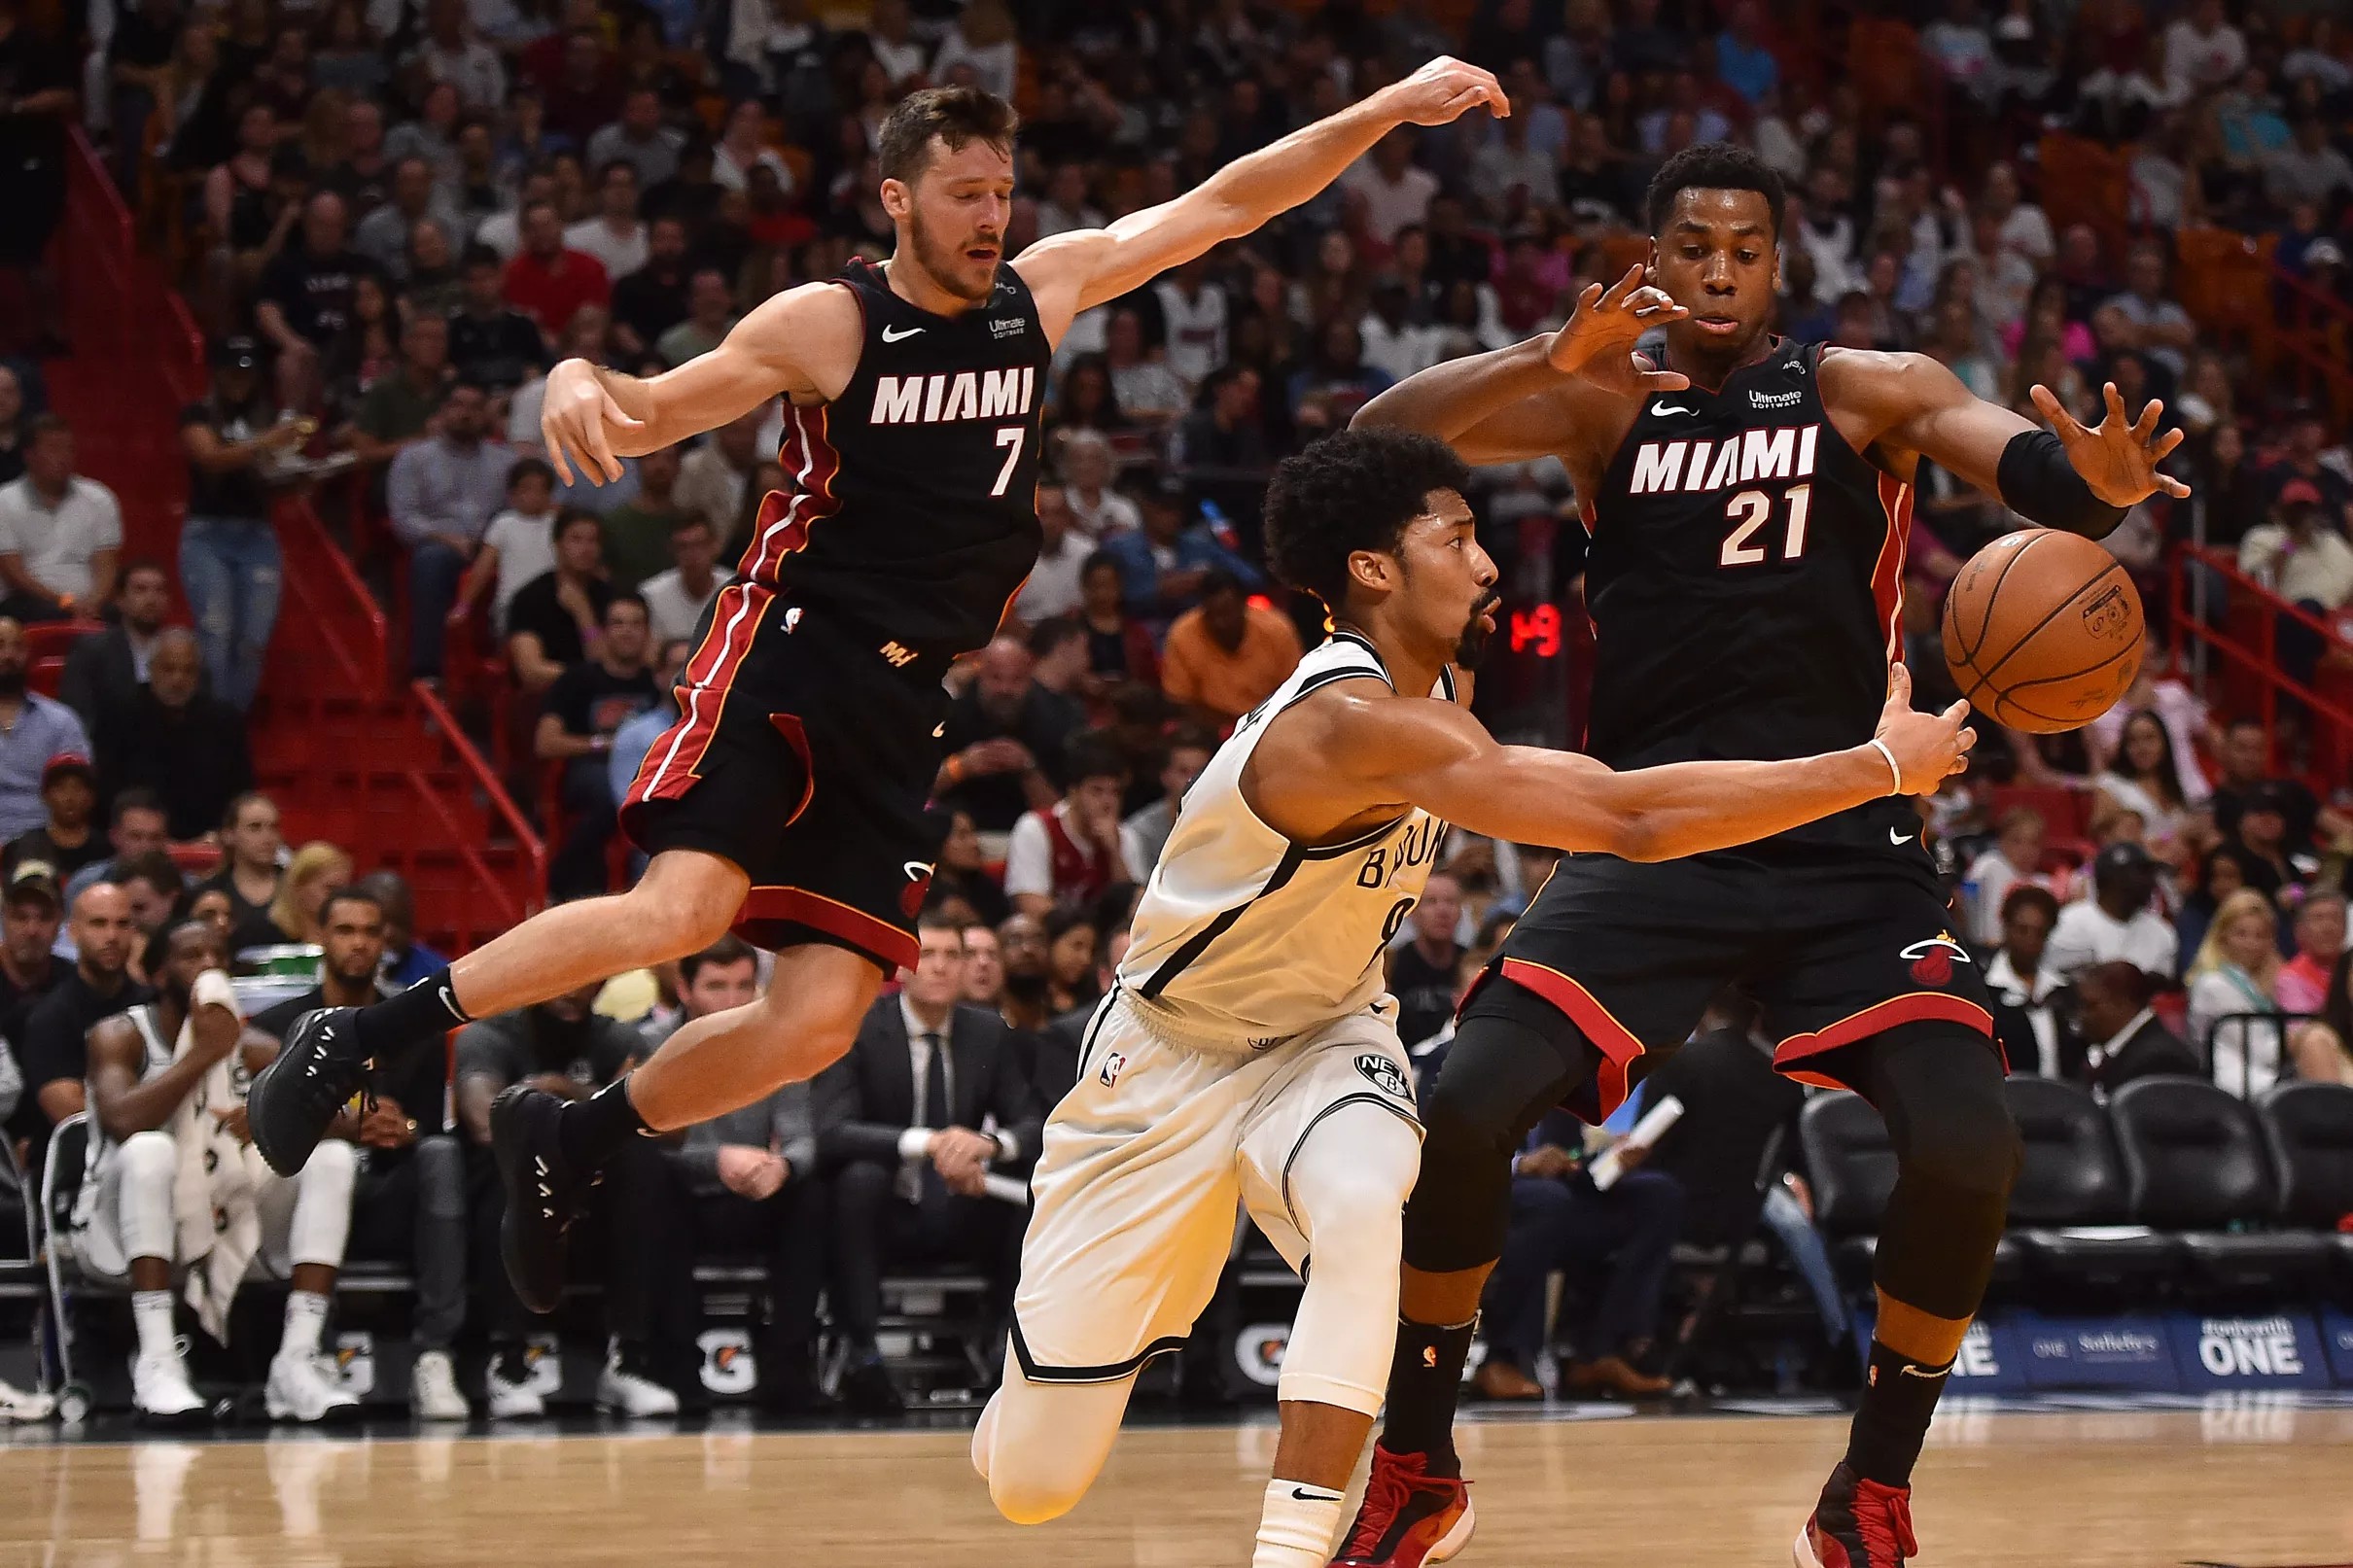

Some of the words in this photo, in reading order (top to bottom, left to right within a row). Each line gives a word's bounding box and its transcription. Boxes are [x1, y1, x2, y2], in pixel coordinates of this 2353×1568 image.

[869, 366, 1035, 425] MIAMI
[1748, 389, 1802, 403] Ultimate
[1751, 399, 1801, 409] SOFTWARE
[989, 426, 1026, 498] 7
[1628, 424, 1820, 495] MIAMI
[1718, 482, 1811, 568] 21
[695, 1328, 757, 1395] G
[2199, 1333, 2304, 1376] ONE
